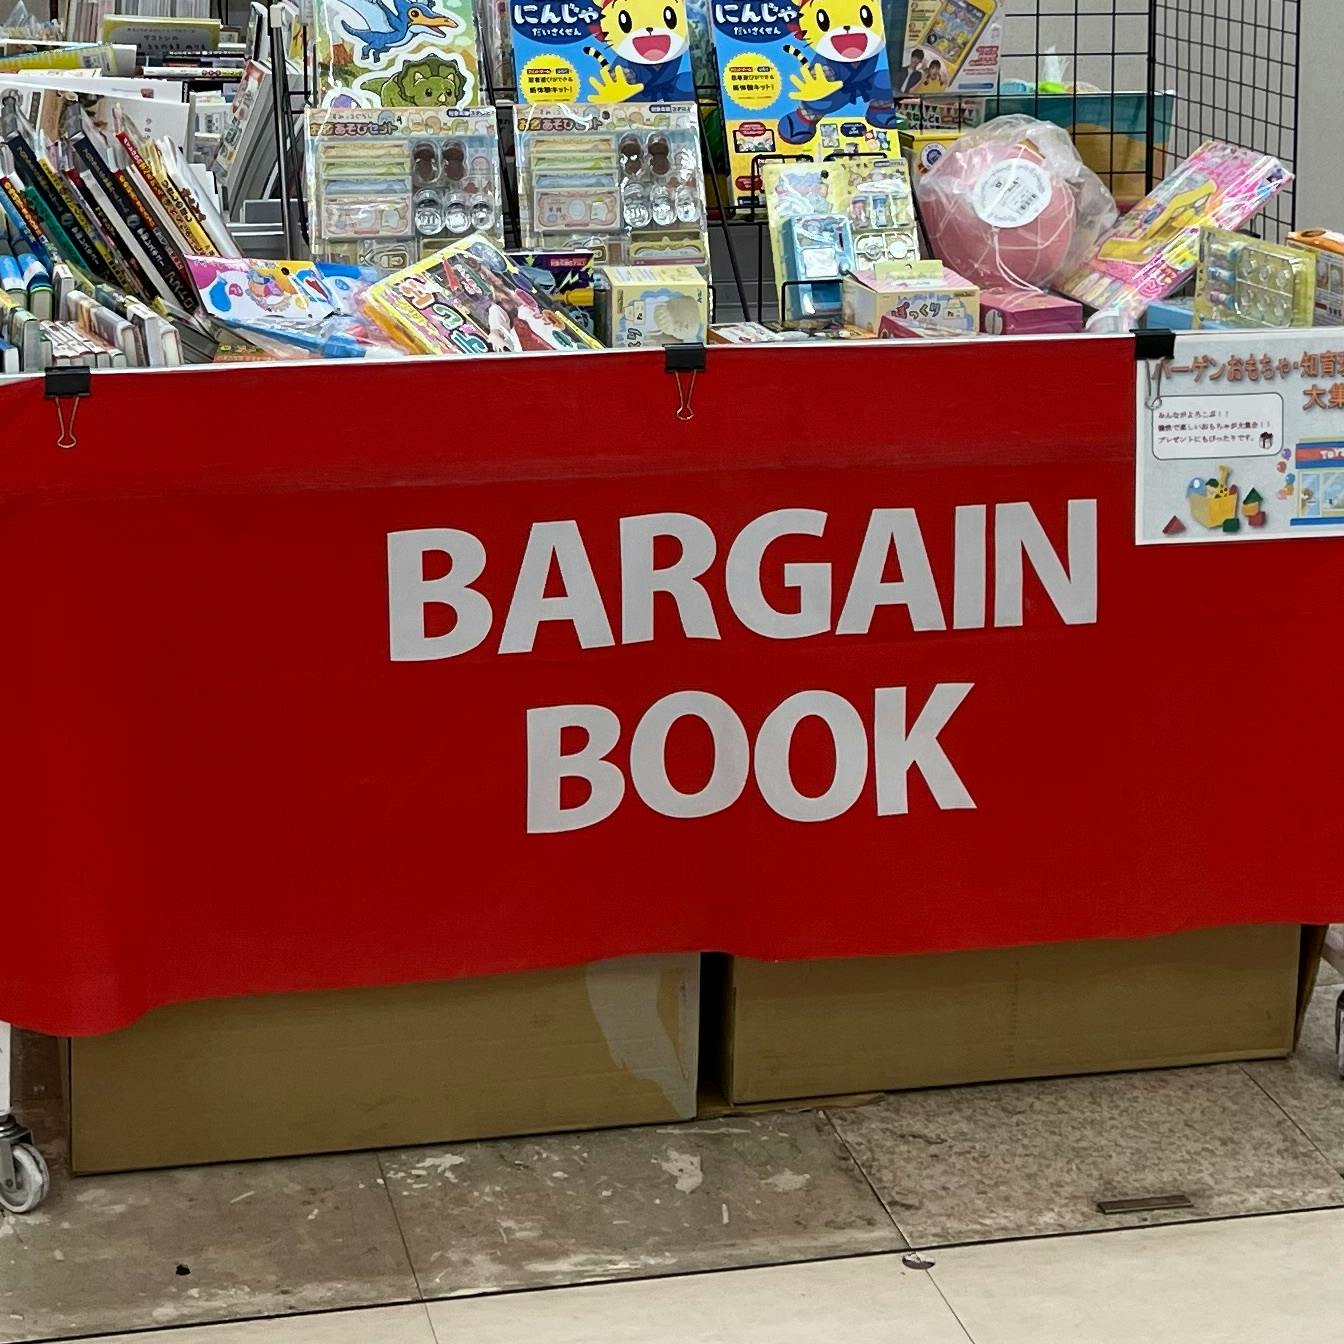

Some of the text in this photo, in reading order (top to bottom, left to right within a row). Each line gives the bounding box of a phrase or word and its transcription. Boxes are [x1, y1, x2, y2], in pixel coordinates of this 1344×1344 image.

[514, 4, 600, 25] にんじゃ
[714, 3, 799, 25] にんじゃ
[531, 27, 582, 37] だいさくせん
[732, 26, 782, 36] だいさくせん
[386, 498, 1098, 662] BARGAIN
[526, 682, 978, 834] BOOK
